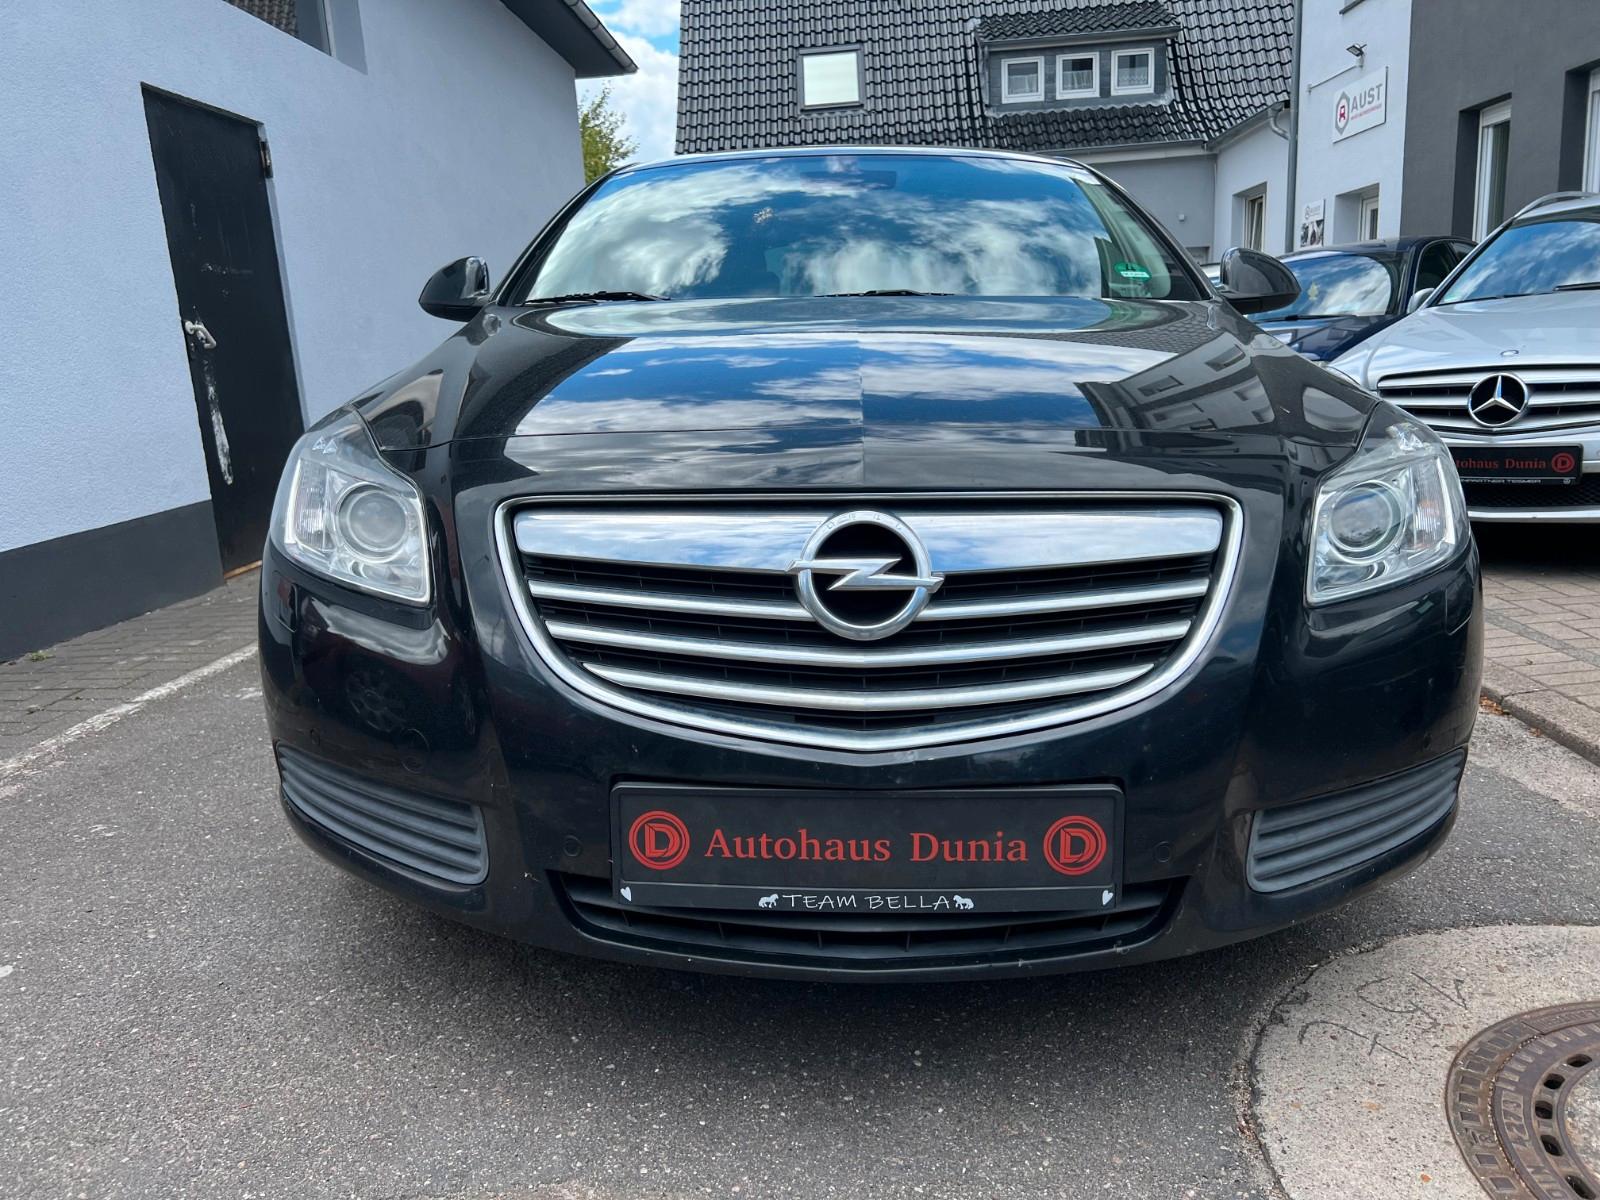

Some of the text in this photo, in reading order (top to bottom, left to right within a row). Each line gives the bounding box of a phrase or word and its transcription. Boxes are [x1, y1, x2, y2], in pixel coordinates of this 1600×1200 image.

[1351, 83, 1383, 112] AUST
[1456, 457, 1499, 469] tohaus
[1505, 457, 1547, 469] Dunia
[704, 828, 892, 862] Autohaus
[909, 831, 1029, 863] Dunia
[782, 894, 950, 911] TEAM BELLA
